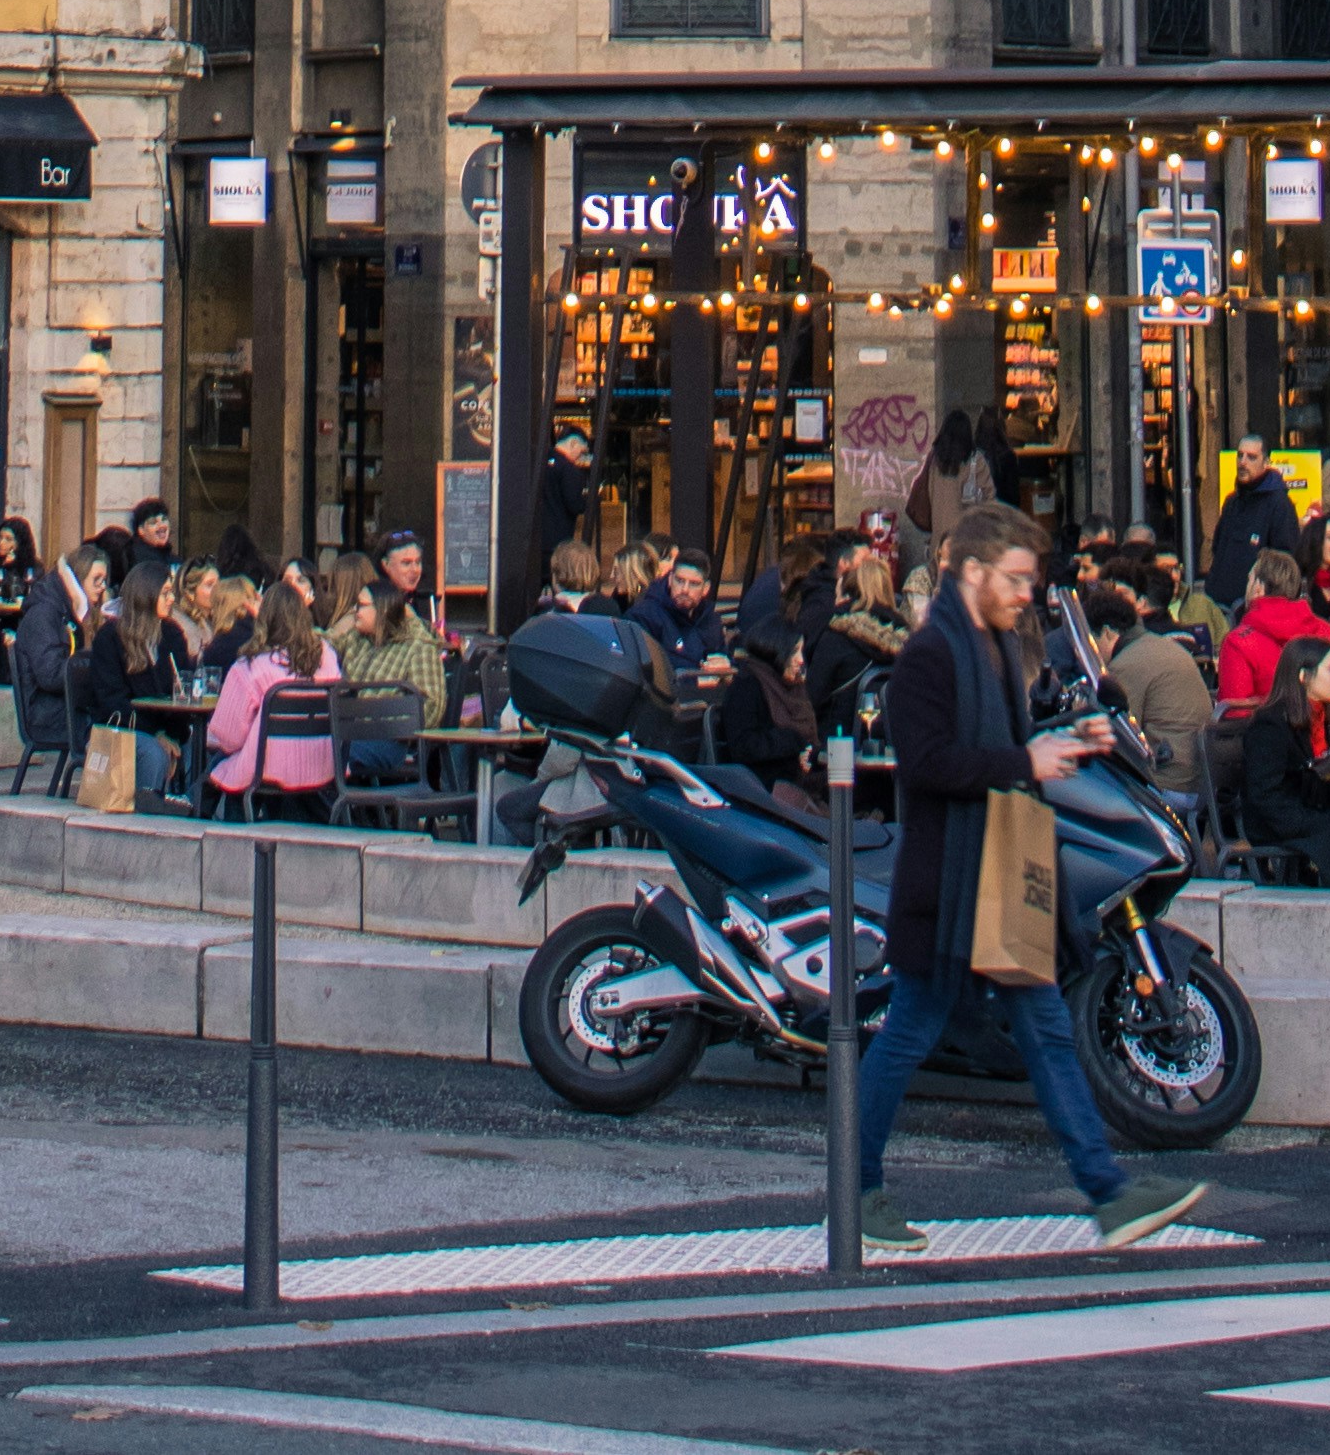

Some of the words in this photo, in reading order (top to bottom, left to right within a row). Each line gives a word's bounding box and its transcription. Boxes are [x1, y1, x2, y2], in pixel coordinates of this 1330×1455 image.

[40, 157, 70, 185] Bar
[213, 185, 262, 197] SHOUKA
[1269, 185, 1317, 196] SHOUKA
[582, 194, 797, 234] SHOKA
